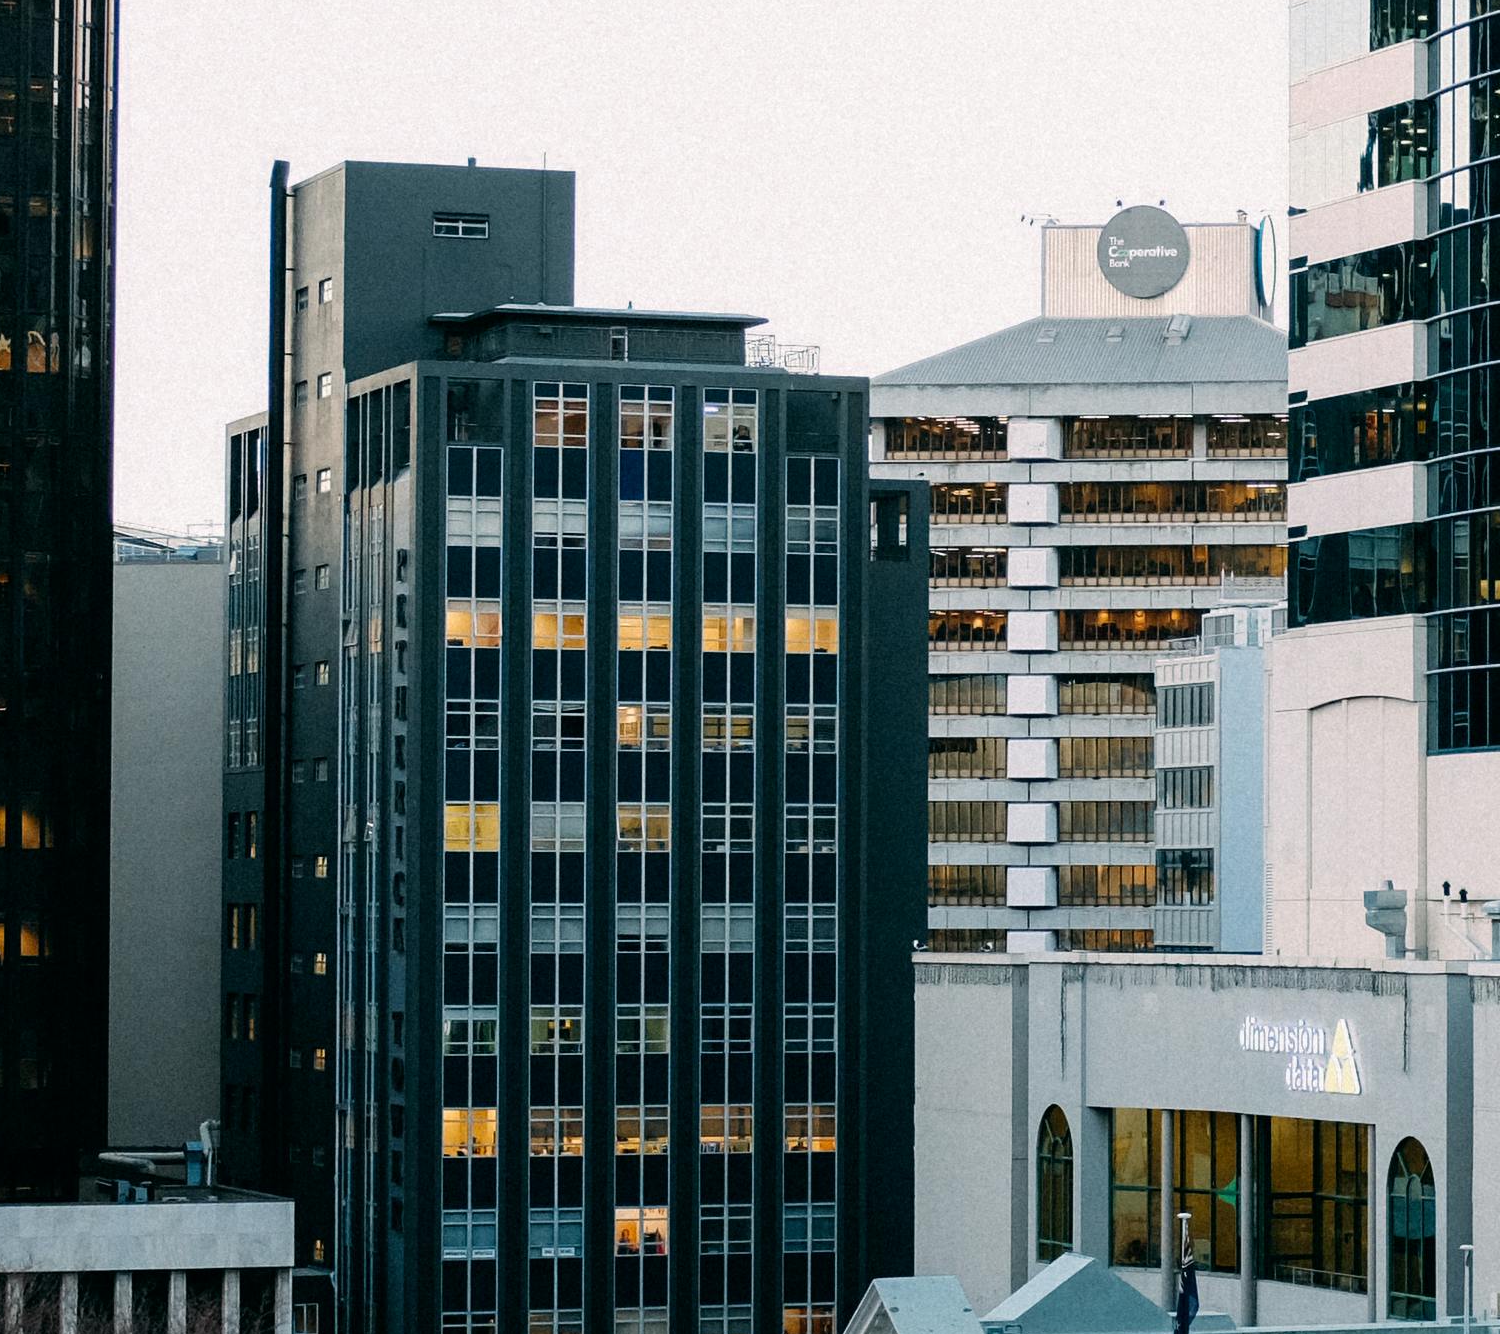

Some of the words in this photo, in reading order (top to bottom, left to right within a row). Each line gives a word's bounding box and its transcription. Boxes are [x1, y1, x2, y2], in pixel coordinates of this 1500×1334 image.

[1109, 237, 1125, 245] The
[1109, 259, 1130, 268] Bank
[1239, 1015, 1326, 1055] dimension
[1285, 1055, 1325, 1092] data
